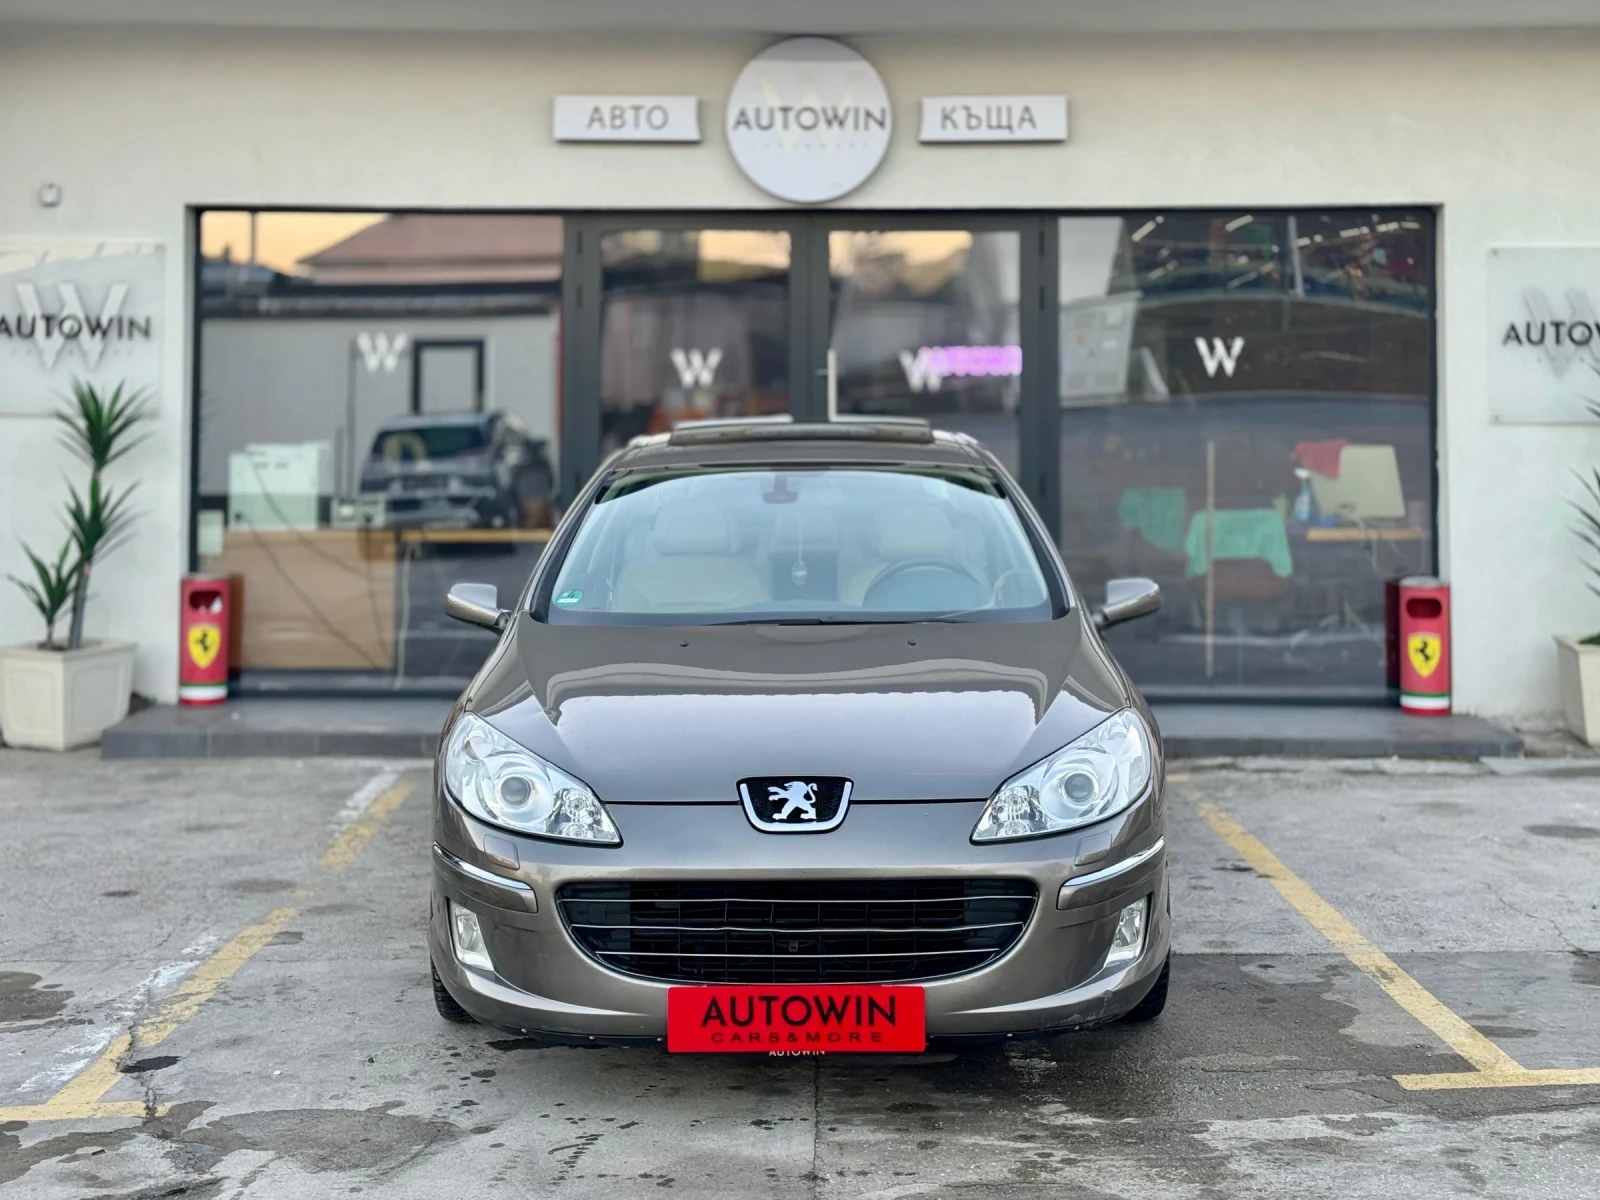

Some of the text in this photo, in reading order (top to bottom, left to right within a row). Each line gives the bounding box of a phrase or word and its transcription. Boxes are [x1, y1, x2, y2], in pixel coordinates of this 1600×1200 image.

[586, 104, 669, 130] АВТО
[732, 106, 887, 130] AUTOWIN
[940, 104, 1038, 132] КЪЩА
[1501, 320, 1600, 346] AUTO
[357, 332, 407, 373] W
[1195, 336, 1244, 378] W
[670, 347, 723, 388] W
[702, 995, 896, 1027] AUTOWIN
[711, 1031, 884, 1043] CARS&MORE
